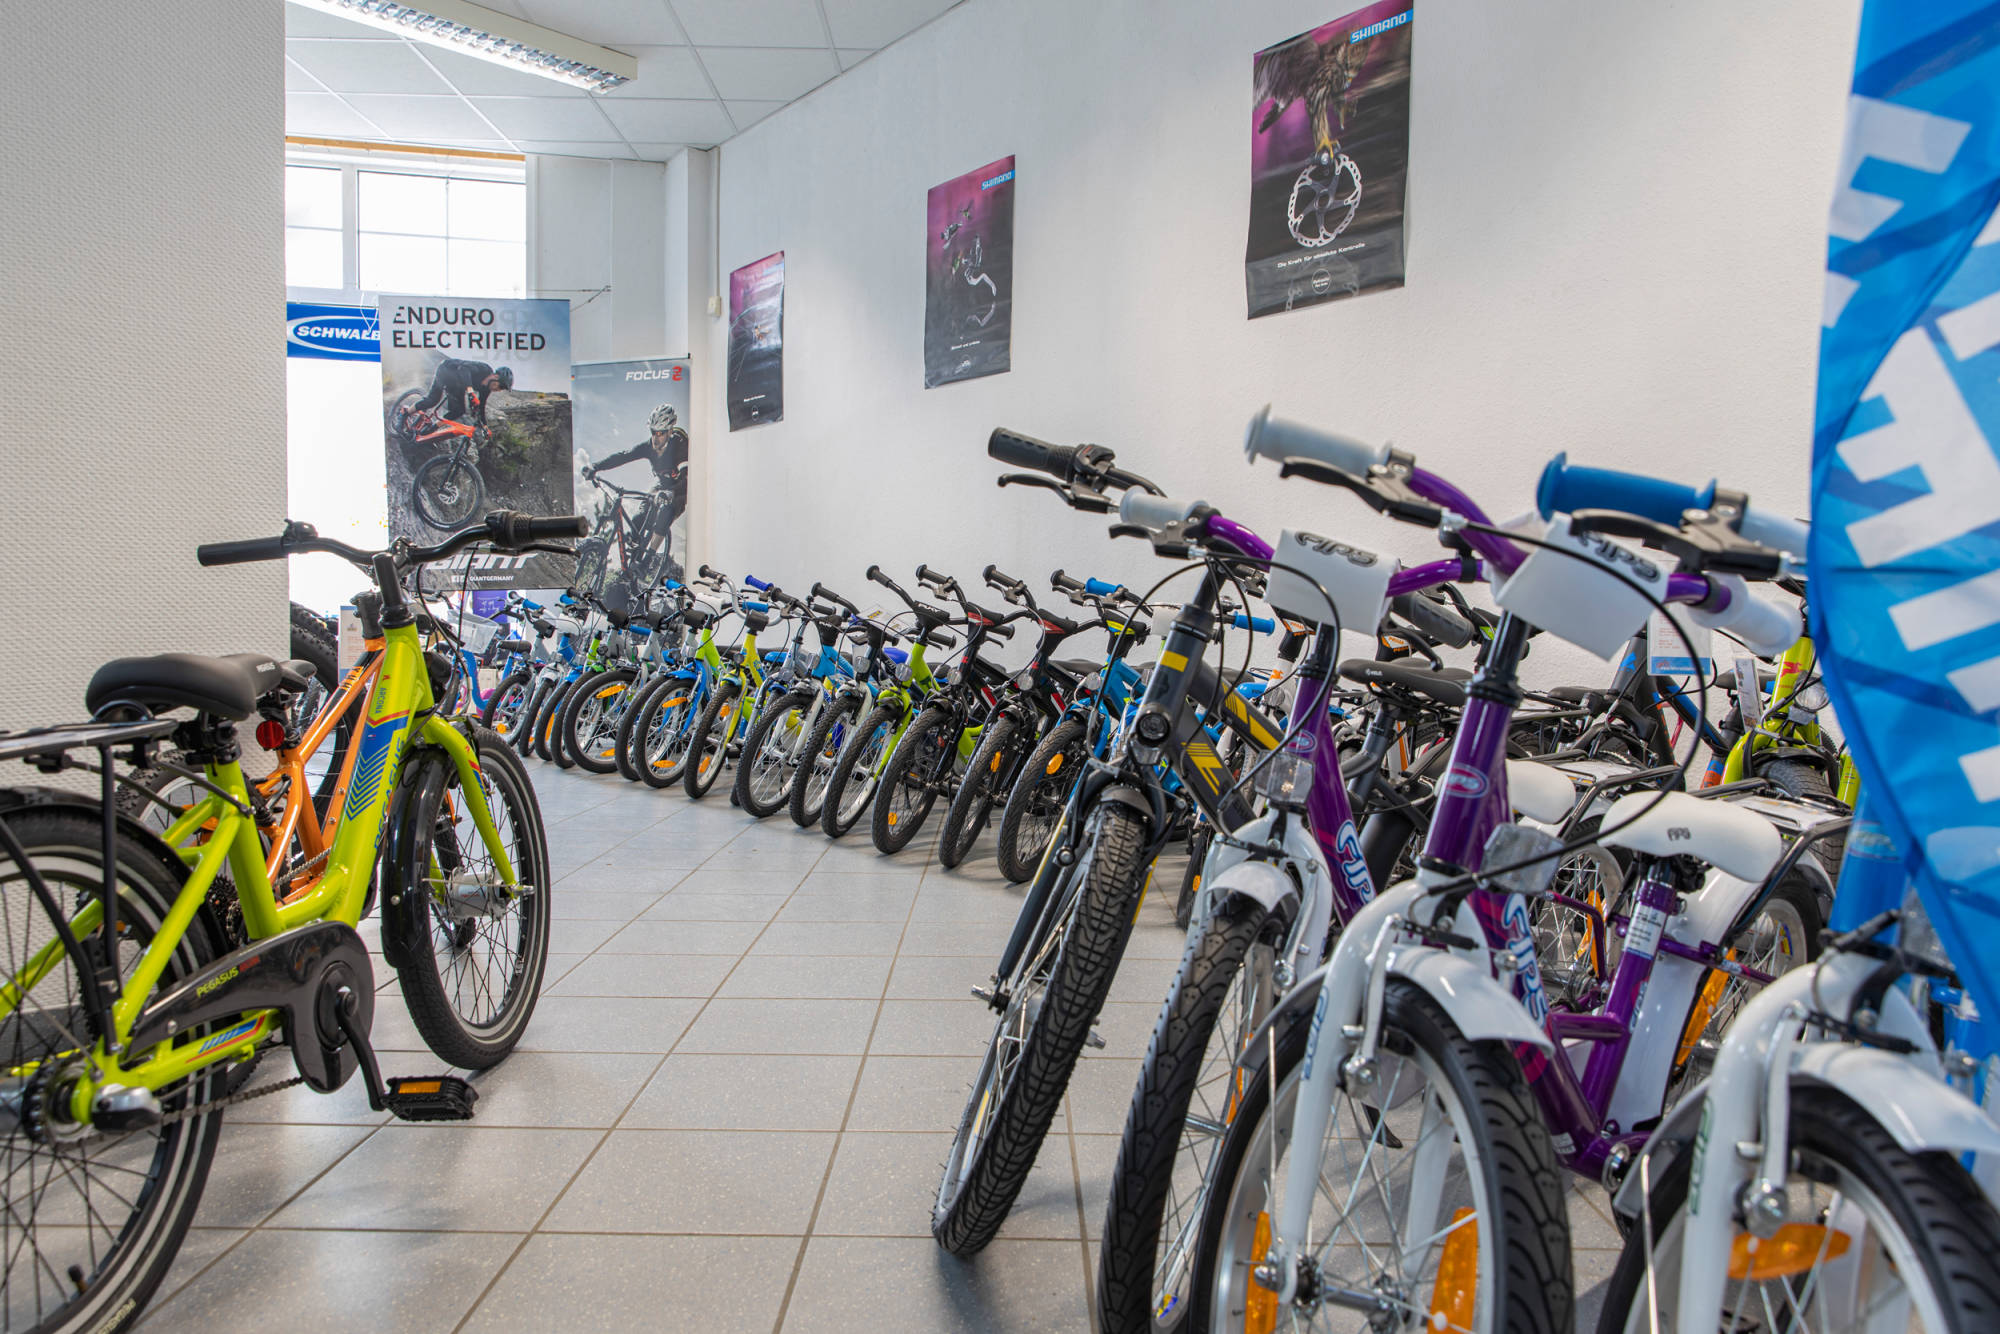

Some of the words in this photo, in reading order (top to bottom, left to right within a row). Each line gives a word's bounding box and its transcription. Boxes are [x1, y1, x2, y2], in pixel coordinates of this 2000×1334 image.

[1351, 13, 1407, 43] SHIMANO
[982, 170, 1012, 190] SHIMANO
[393, 305, 494, 326] ENDURO
[296, 325, 380, 341] SCHWALB
[392, 330, 546, 351] ELECTRIFIED
[625, 369, 670, 381] FOCUS
[426, 553, 538, 570] GIANT
[196, 966, 240, 998] PEGASUS
